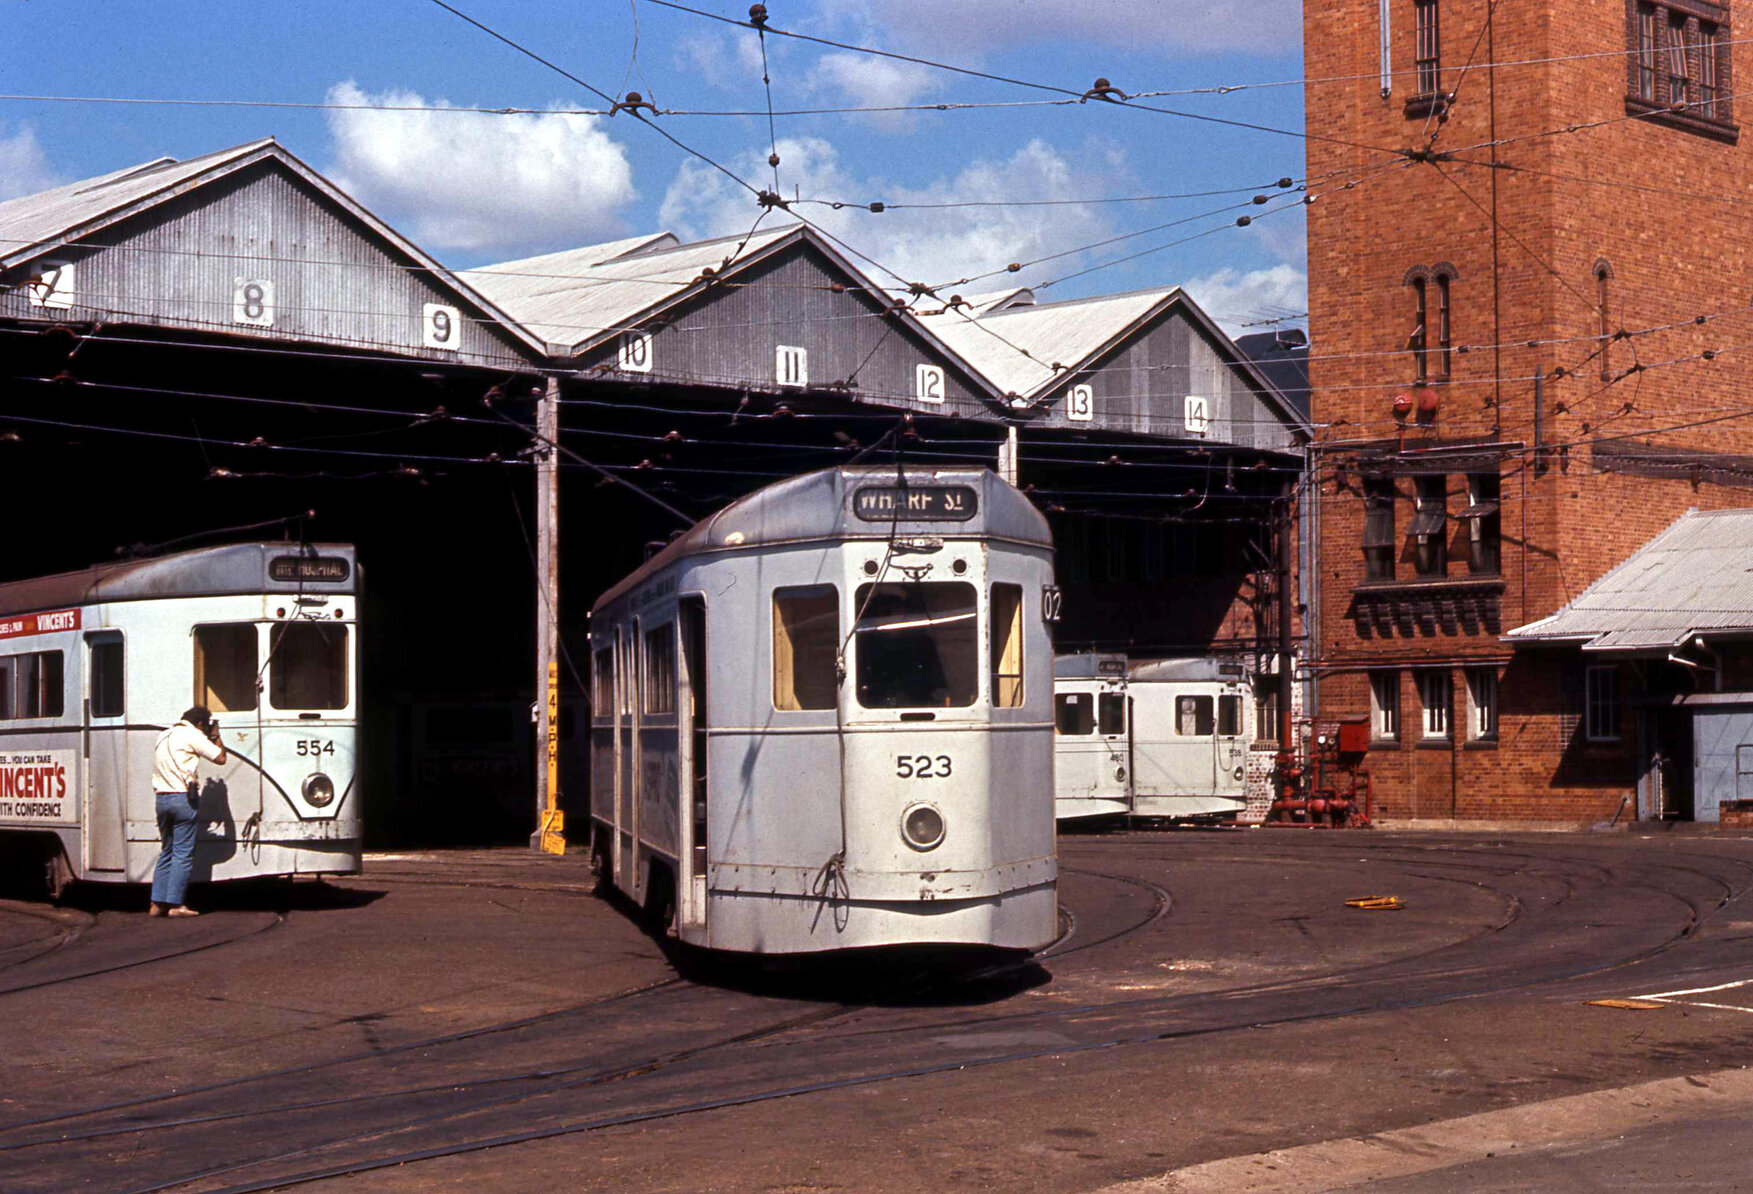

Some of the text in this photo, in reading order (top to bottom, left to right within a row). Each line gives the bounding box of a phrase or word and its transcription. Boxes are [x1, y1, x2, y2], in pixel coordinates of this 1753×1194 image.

[41, 263, 62, 298] 7
[243, 283, 264, 318] 8
[433, 310, 451, 342] 9
[625, 333, 647, 366] 10
[785, 351, 799, 383] 11
[921, 369, 940, 398] 12
[1072, 387, 1089, 415] 13
[1189, 400, 1205, 427] 14
[1044, 591, 1061, 620] 02
[549, 694, 557, 709] 4
[24, 755, 35, 764] CAN
[36, 754, 51, 764] TAKE
[296, 740, 335, 756] 554
[896, 755, 952, 779] 523
[15, 802, 61, 817] CONFIDENCE
